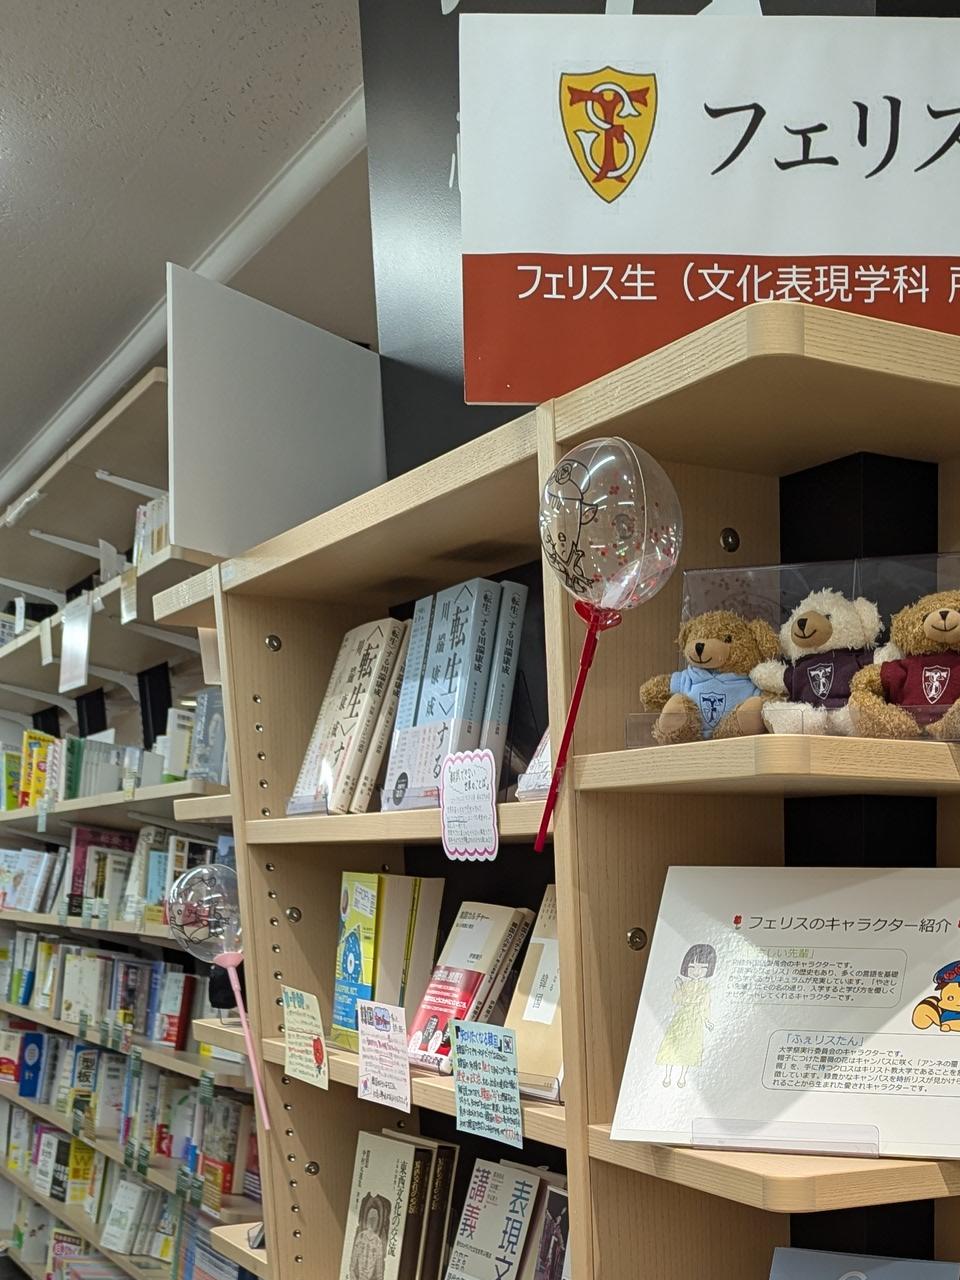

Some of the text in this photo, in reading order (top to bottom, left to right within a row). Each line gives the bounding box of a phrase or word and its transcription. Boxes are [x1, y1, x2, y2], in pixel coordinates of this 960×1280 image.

[748, 914, 952, 934] フェリスのキャラクター紹介
[778, 1046, 904, 1057] 大学祭実行委員会のキャラクターです。
